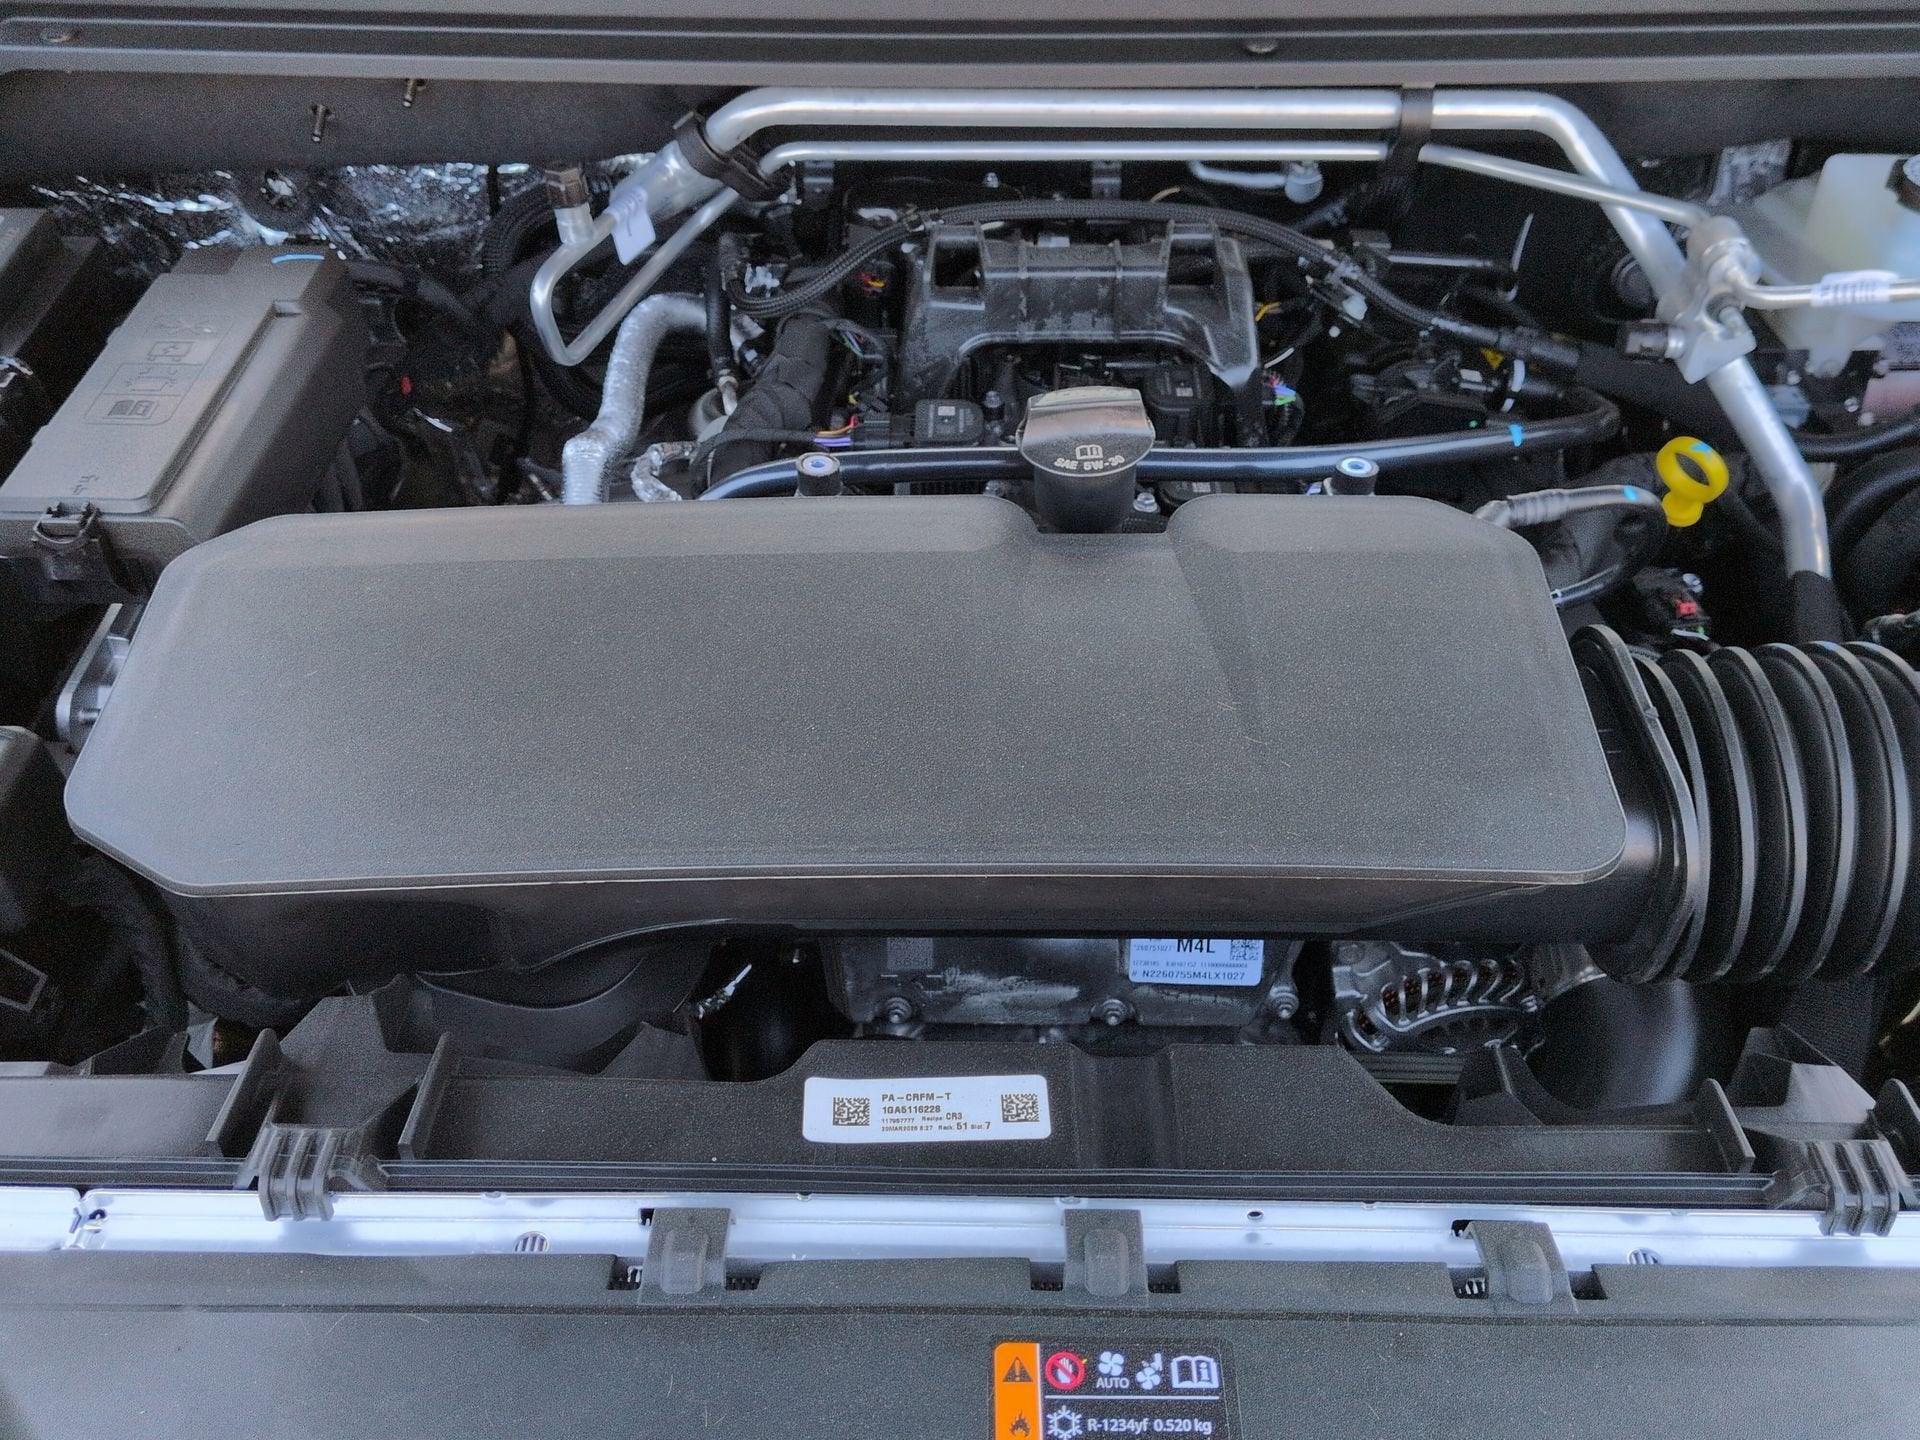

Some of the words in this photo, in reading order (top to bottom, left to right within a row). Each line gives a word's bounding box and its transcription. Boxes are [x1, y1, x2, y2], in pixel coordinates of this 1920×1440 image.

[1054, 457, 1079, 470] SAE
[1083, 455, 1125, 471] 5W-30
[1176, 939, 1216, 953] M4L
[1142, 969, 1246, 980] N2260755M4LX1027
[945, 1112, 963, 1120] CR3
[956, 1122, 968, 1130] 51
[1096, 1377, 1130, 1389] AUTO
[1087, 1418, 1148, 1435] R-1234yf
[1153, 1418, 1192, 1432] 0.520
[1194, 1418, 1212, 1434] kg
